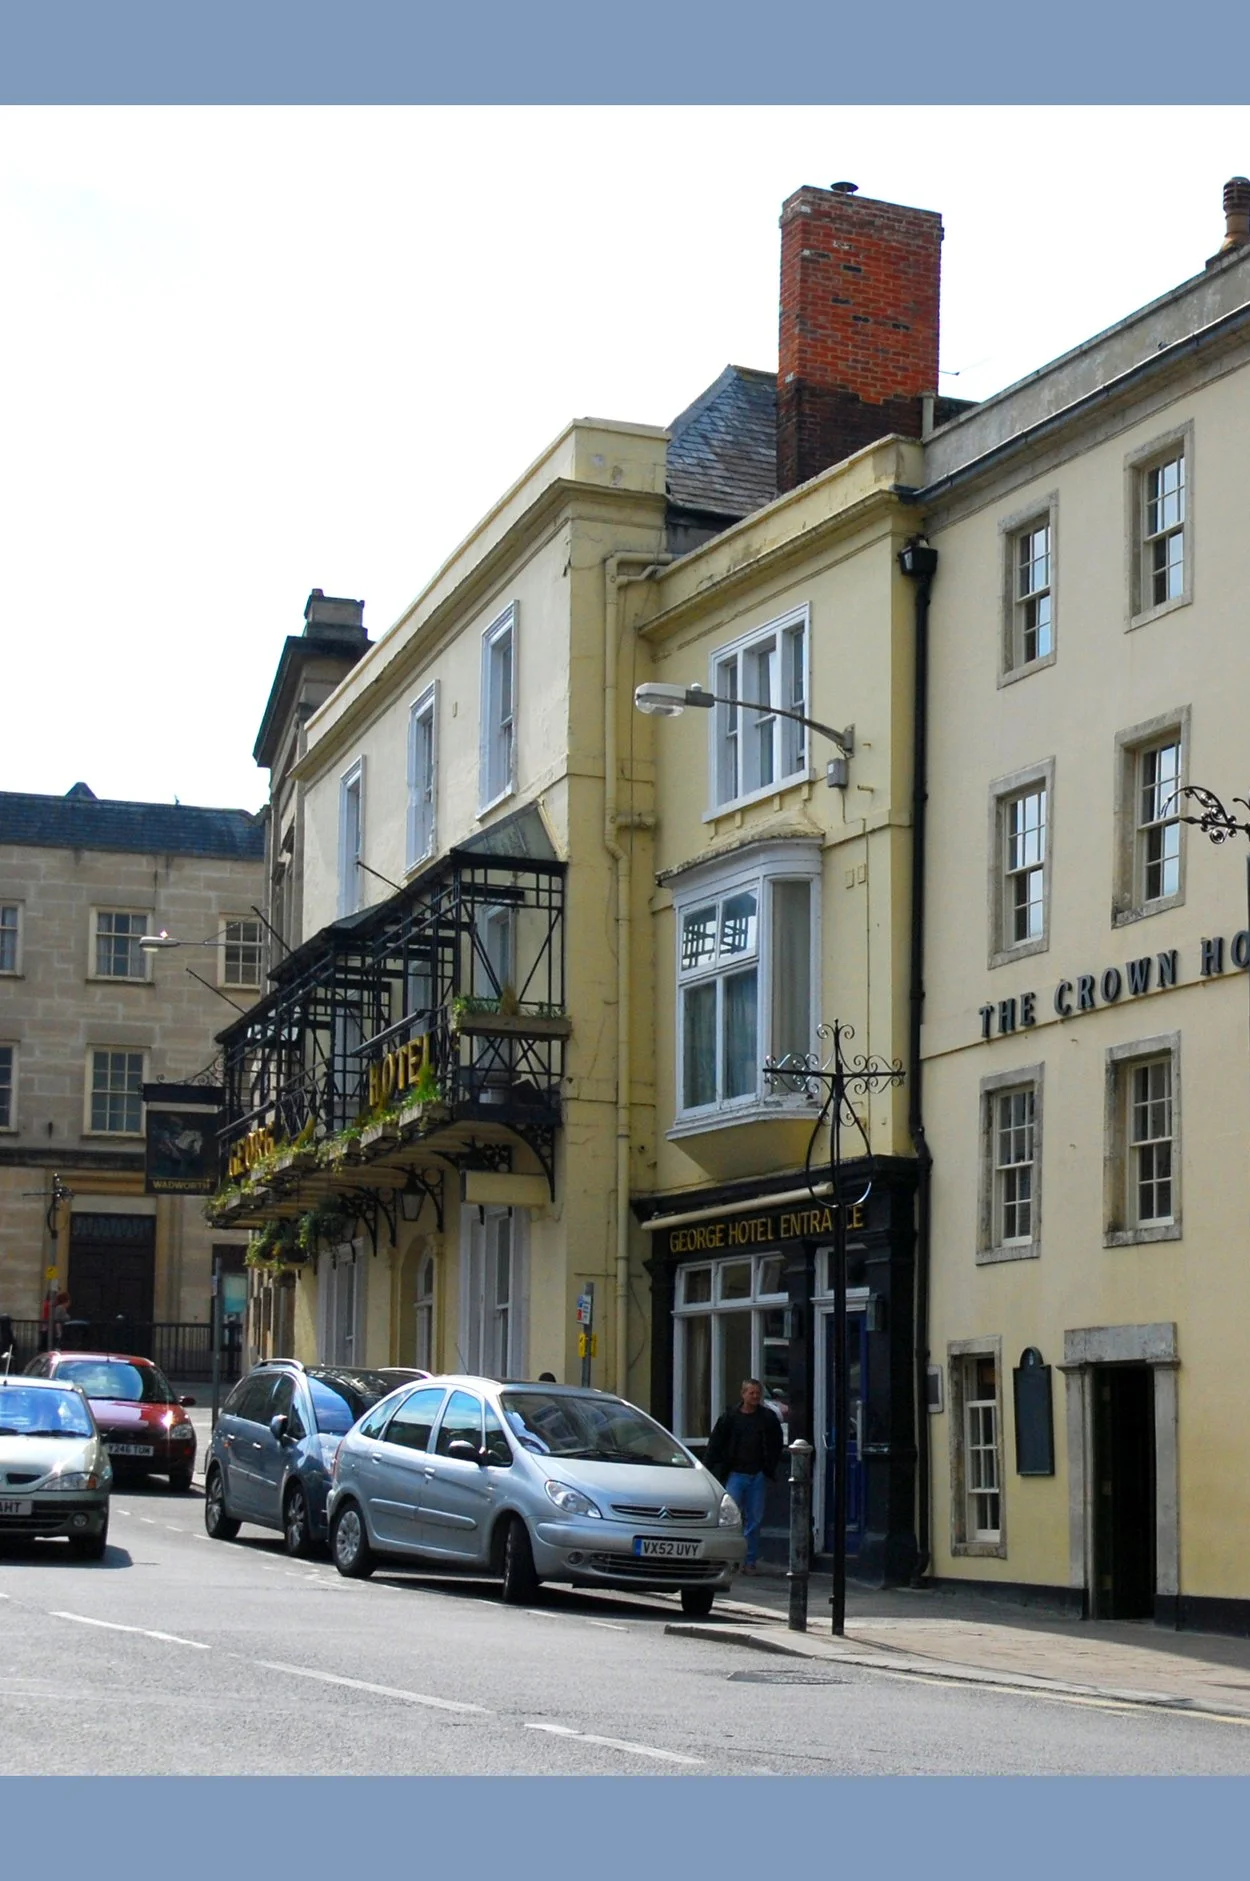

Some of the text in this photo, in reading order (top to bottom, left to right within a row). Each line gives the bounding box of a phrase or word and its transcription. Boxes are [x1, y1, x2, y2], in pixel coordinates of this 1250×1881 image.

[979, 991, 1036, 1038] THE
[1053, 949, 1178, 1016] CROWN
[669, 1205, 864, 1252] GEORGE HOTEL ENTRAE
[643, 1541, 699, 1556] VX52 UVY
